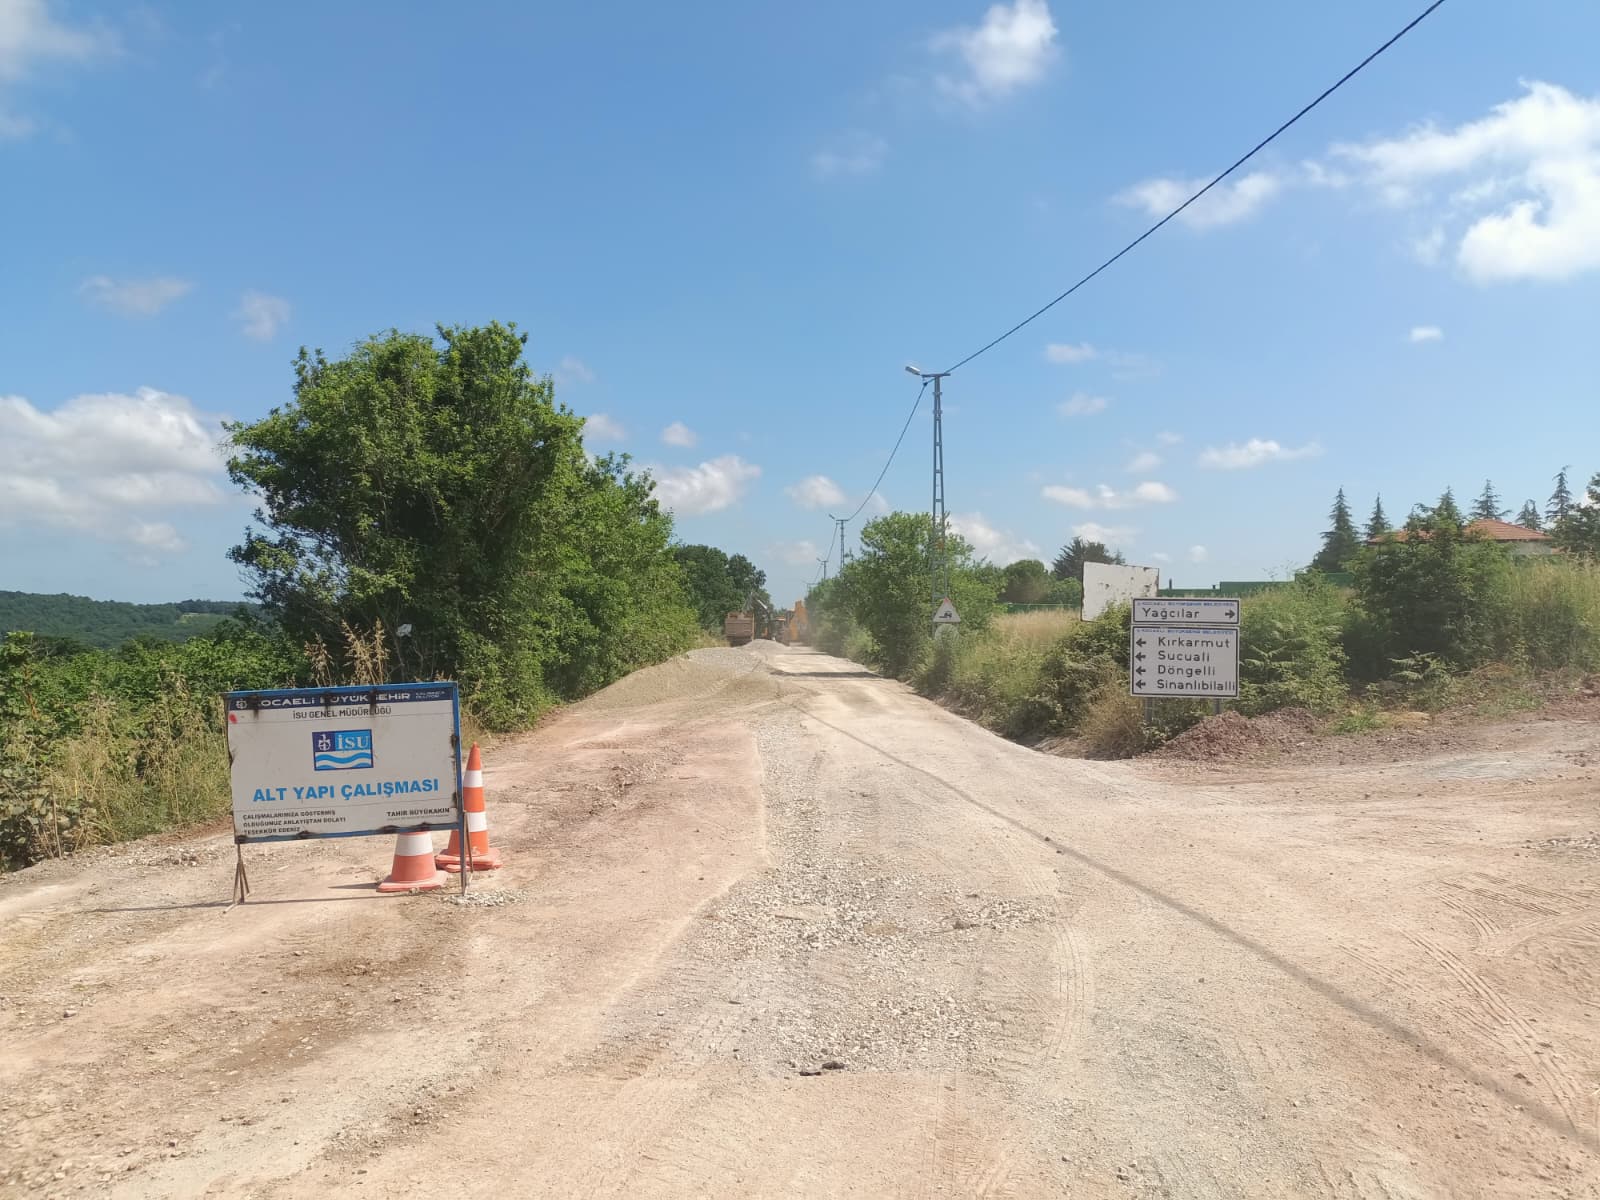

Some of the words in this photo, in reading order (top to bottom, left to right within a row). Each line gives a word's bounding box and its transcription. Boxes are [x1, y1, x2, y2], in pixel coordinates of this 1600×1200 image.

[1142, 607, 1200, 620] Yağcılar
[1158, 636, 1231, 648] Kırkarmut
[1158, 650, 1210, 662] Sucuali
[1158, 664, 1215, 678] Döngelli
[258, 697, 315, 707] OCAELİ
[309, 709, 338, 719] GENEL
[252, 787, 287, 802] ALT
[293, 785, 335, 800] YAPI
[341, 778, 438, 800] ÇALIŞMASI
